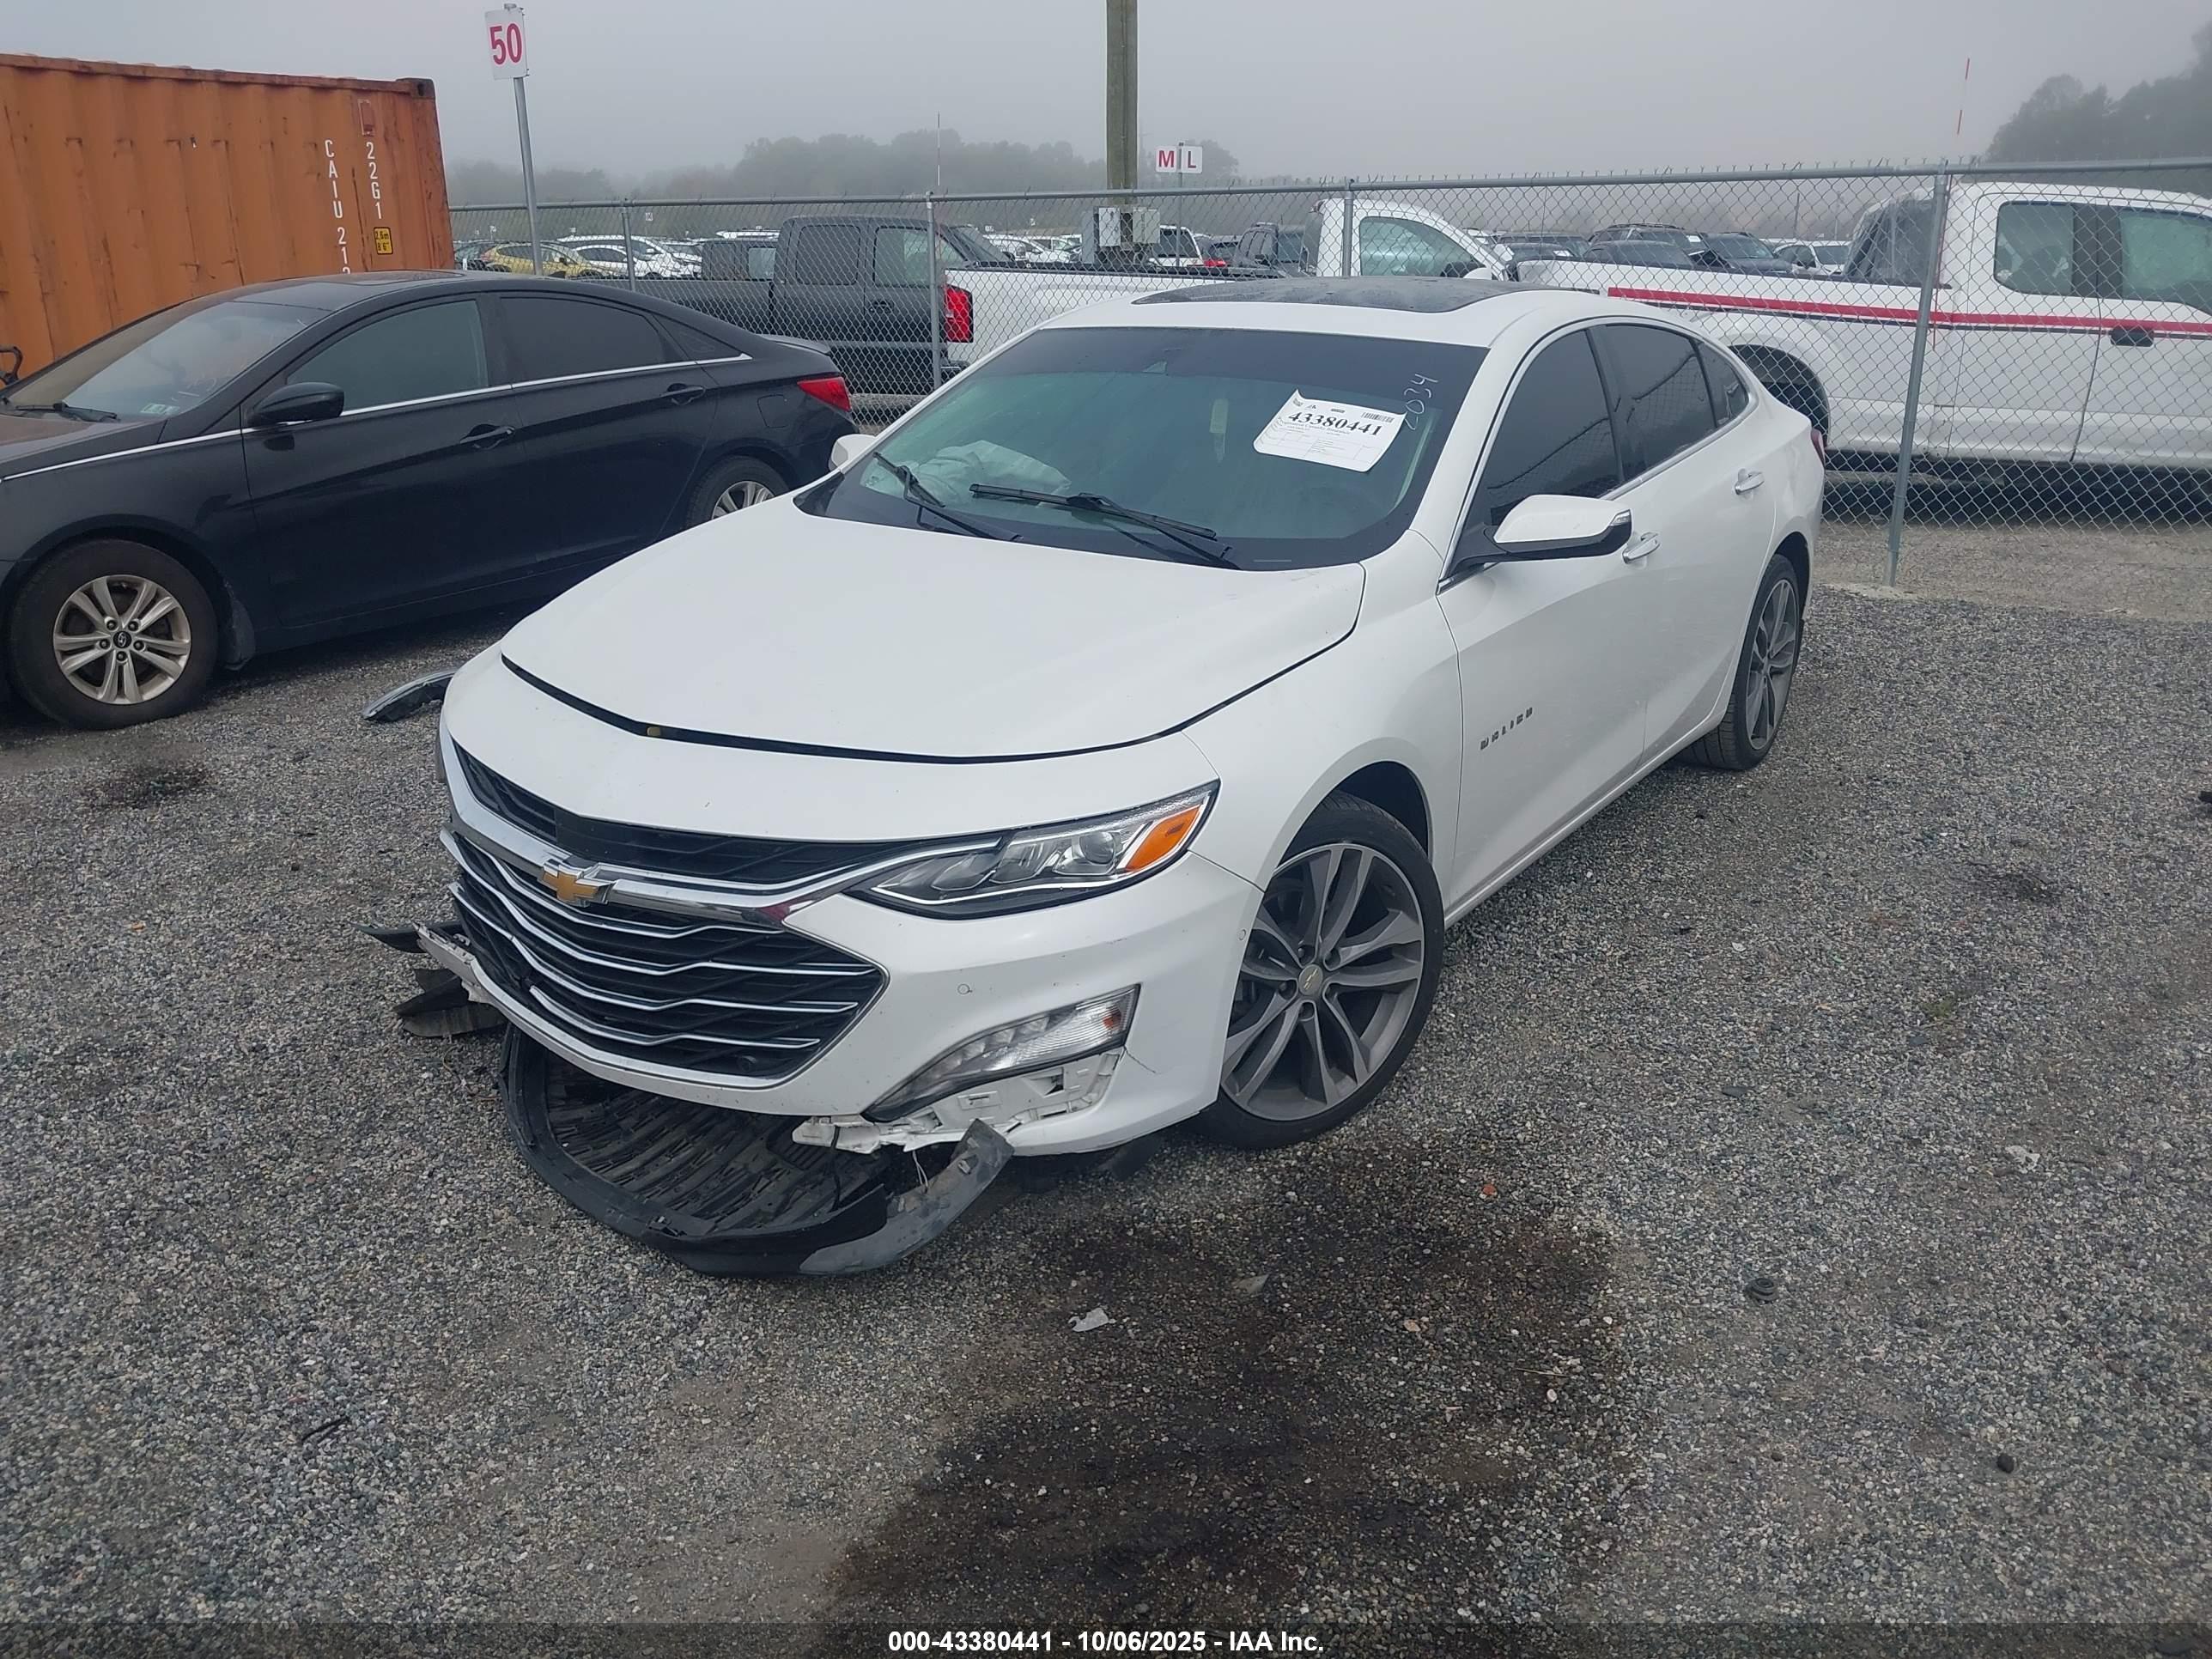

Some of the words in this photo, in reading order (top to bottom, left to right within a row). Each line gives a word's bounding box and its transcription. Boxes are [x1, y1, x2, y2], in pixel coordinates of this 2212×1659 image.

[489, 23, 522, 64] 50
[1158, 150, 1174, 167] M
[1188, 150, 1196, 168] L
[325, 140, 343, 218] CAIU
[366, 142, 381, 219] 22G1
[1288, 410, 1382, 436] 43380441
